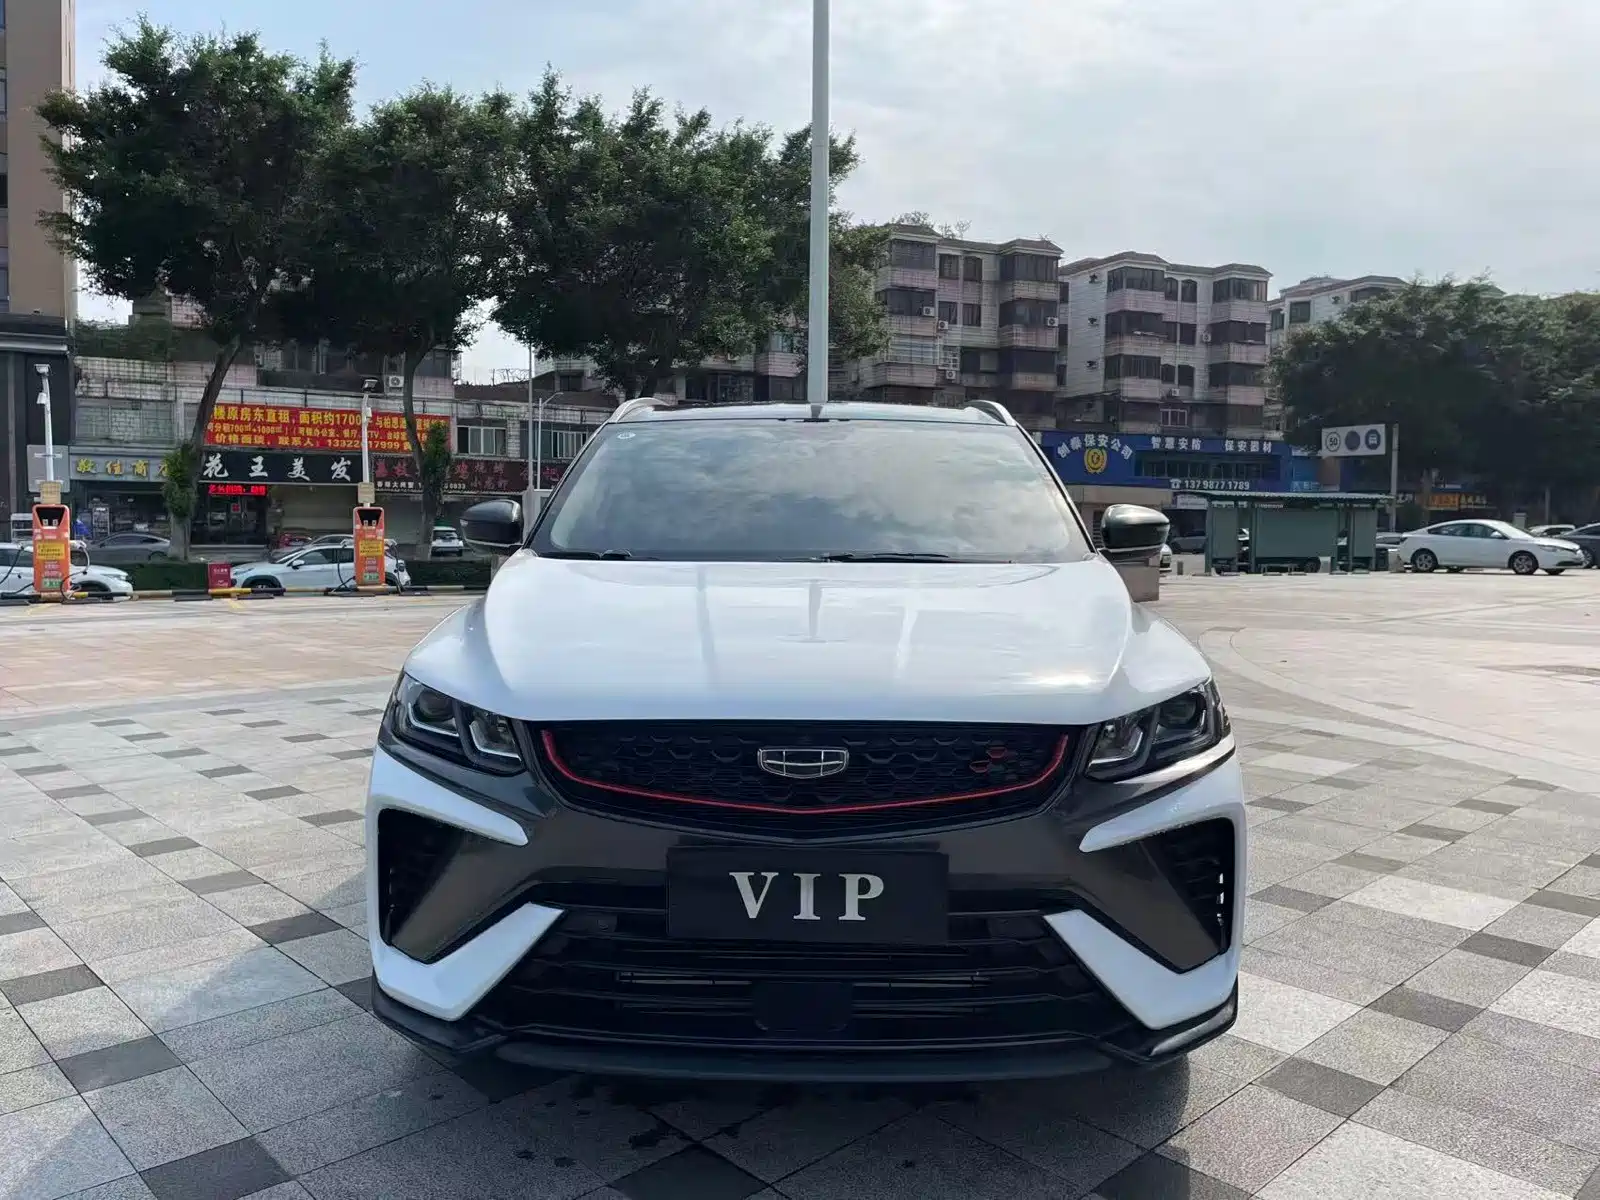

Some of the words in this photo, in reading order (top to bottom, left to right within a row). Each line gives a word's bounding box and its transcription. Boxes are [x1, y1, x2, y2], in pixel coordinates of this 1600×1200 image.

[1151, 436, 1202, 450] 智慧安防
[1224, 440, 1272, 453] 保安器材
[203, 453, 352, 482] 花王美发
[729, 872, 885, 922] VIP
